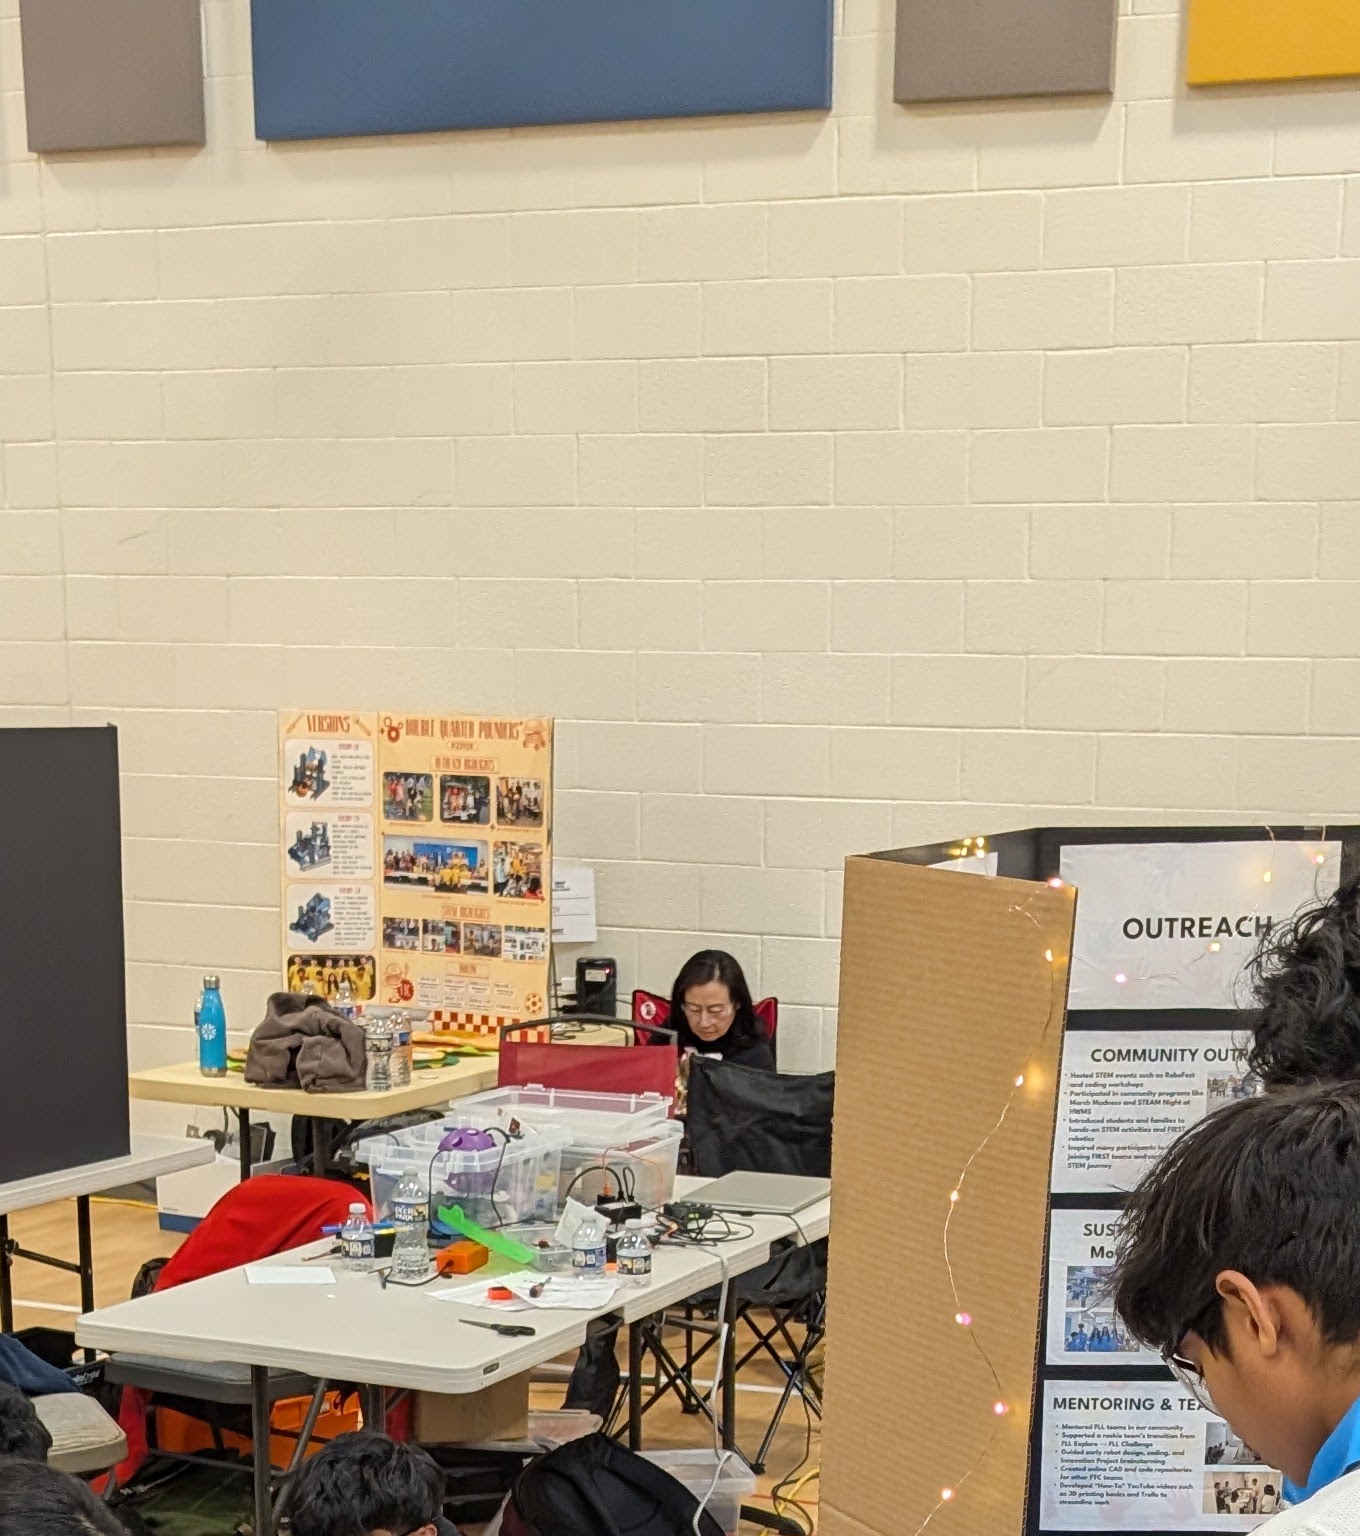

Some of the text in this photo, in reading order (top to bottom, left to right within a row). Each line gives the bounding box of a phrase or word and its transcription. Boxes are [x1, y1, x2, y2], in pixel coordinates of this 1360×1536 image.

[306, 715, 350, 733] VERSIONS
[1122, 915, 1272, 939] OUTREACH
[1091, 1048, 1249, 1062] COMMUNITY OUTR
[1070, 1090, 1110, 1098] Participated
[1053, 1397, 1173, 1411] MENTORING &
